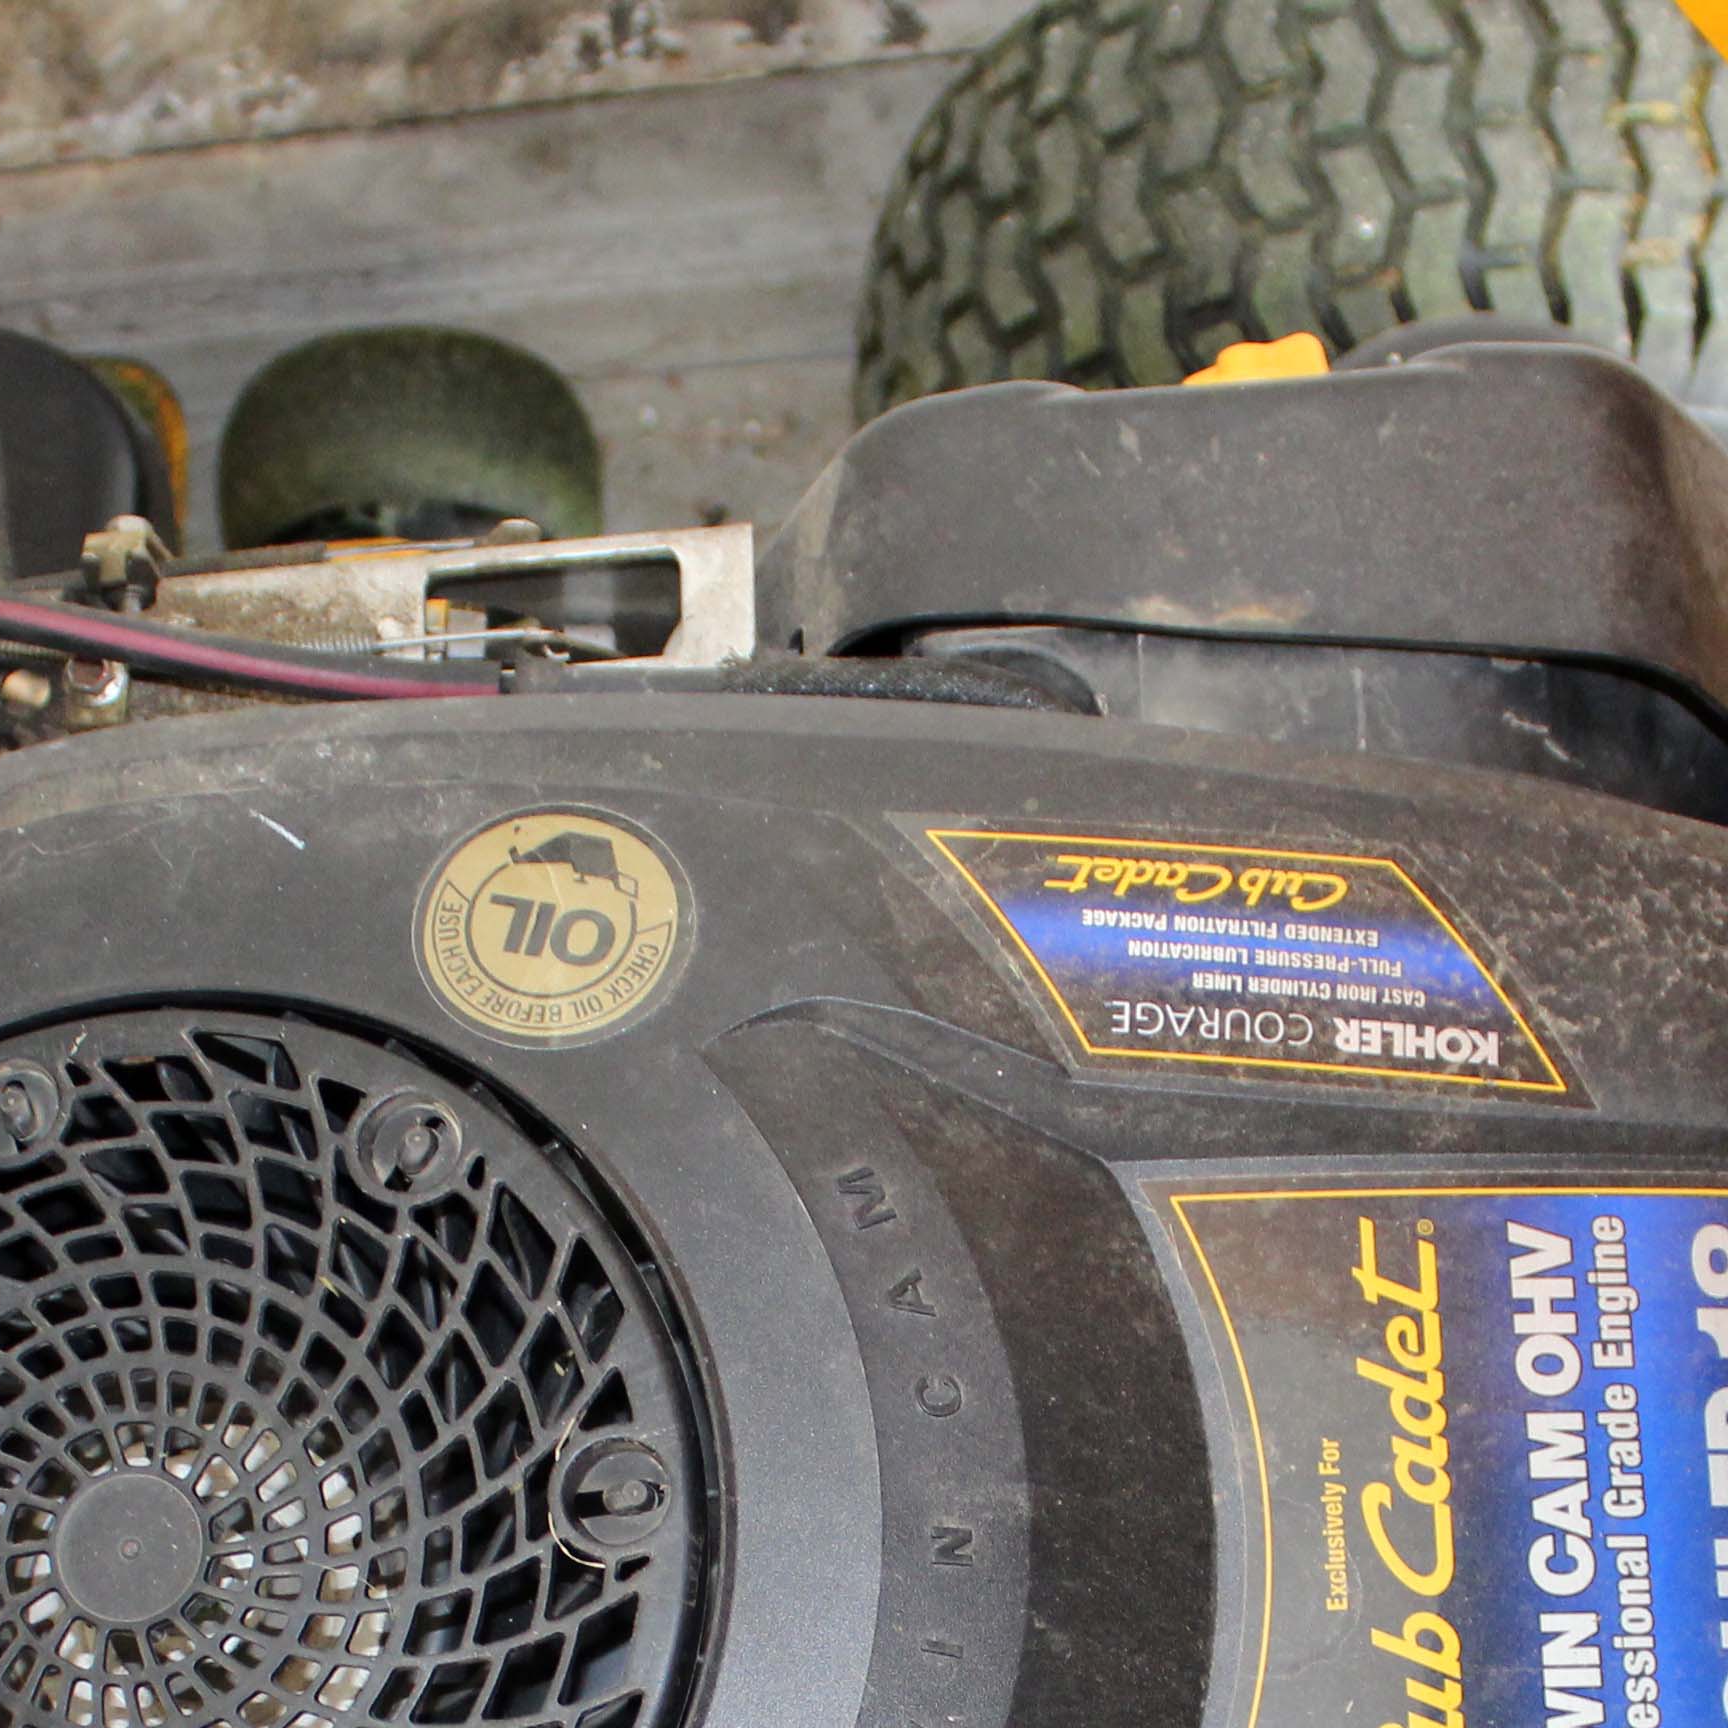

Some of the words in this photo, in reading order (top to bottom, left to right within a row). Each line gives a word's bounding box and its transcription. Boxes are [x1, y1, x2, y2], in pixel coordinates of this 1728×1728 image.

[1044, 854, 1233, 911] Cadet
[1236, 866, 1347, 912] Cub
[438, 902, 464, 947] USE
[488, 893, 616, 967] OIL
[1082, 909, 1168, 933] PACKAGE
[1174, 915, 1278, 940] FILTRATION
[1284, 922, 1378, 947] EXTENDED
[442, 946, 485, 1003] EACH
[602, 942, 659, 1000] CHECK
[1128, 940, 1249, 967] LUBRICATION
[1254, 948, 1402, 978] FULL-PRESSURE
[567, 993, 603, 1018] OIL
[1192, 972, 1243, 993] LINER
[1247, 975, 1331, 1000] CYLINDER
[1336, 983, 1378, 1003] IRON
[1382, 986, 1426, 1007] CAST
[480, 990, 562, 1024] BEFORE
[1108, 1000, 1314, 1046] COURAGE
[1333, 1015, 1499, 1066] KOHLER
[836, 1165, 965, 1418] CAM
[1507, 1220, 1583, 1397] OHV
[1588, 1216, 1639, 1369] Engine
[1351, 1218, 1457, 1594] Cadet
[1316, 1438, 1342, 1474] For
[1604, 1385, 1648, 1518] Grade
[1524, 1411, 1596, 1598] CAM
[1318, 1483, 1349, 1612] Exclusively
